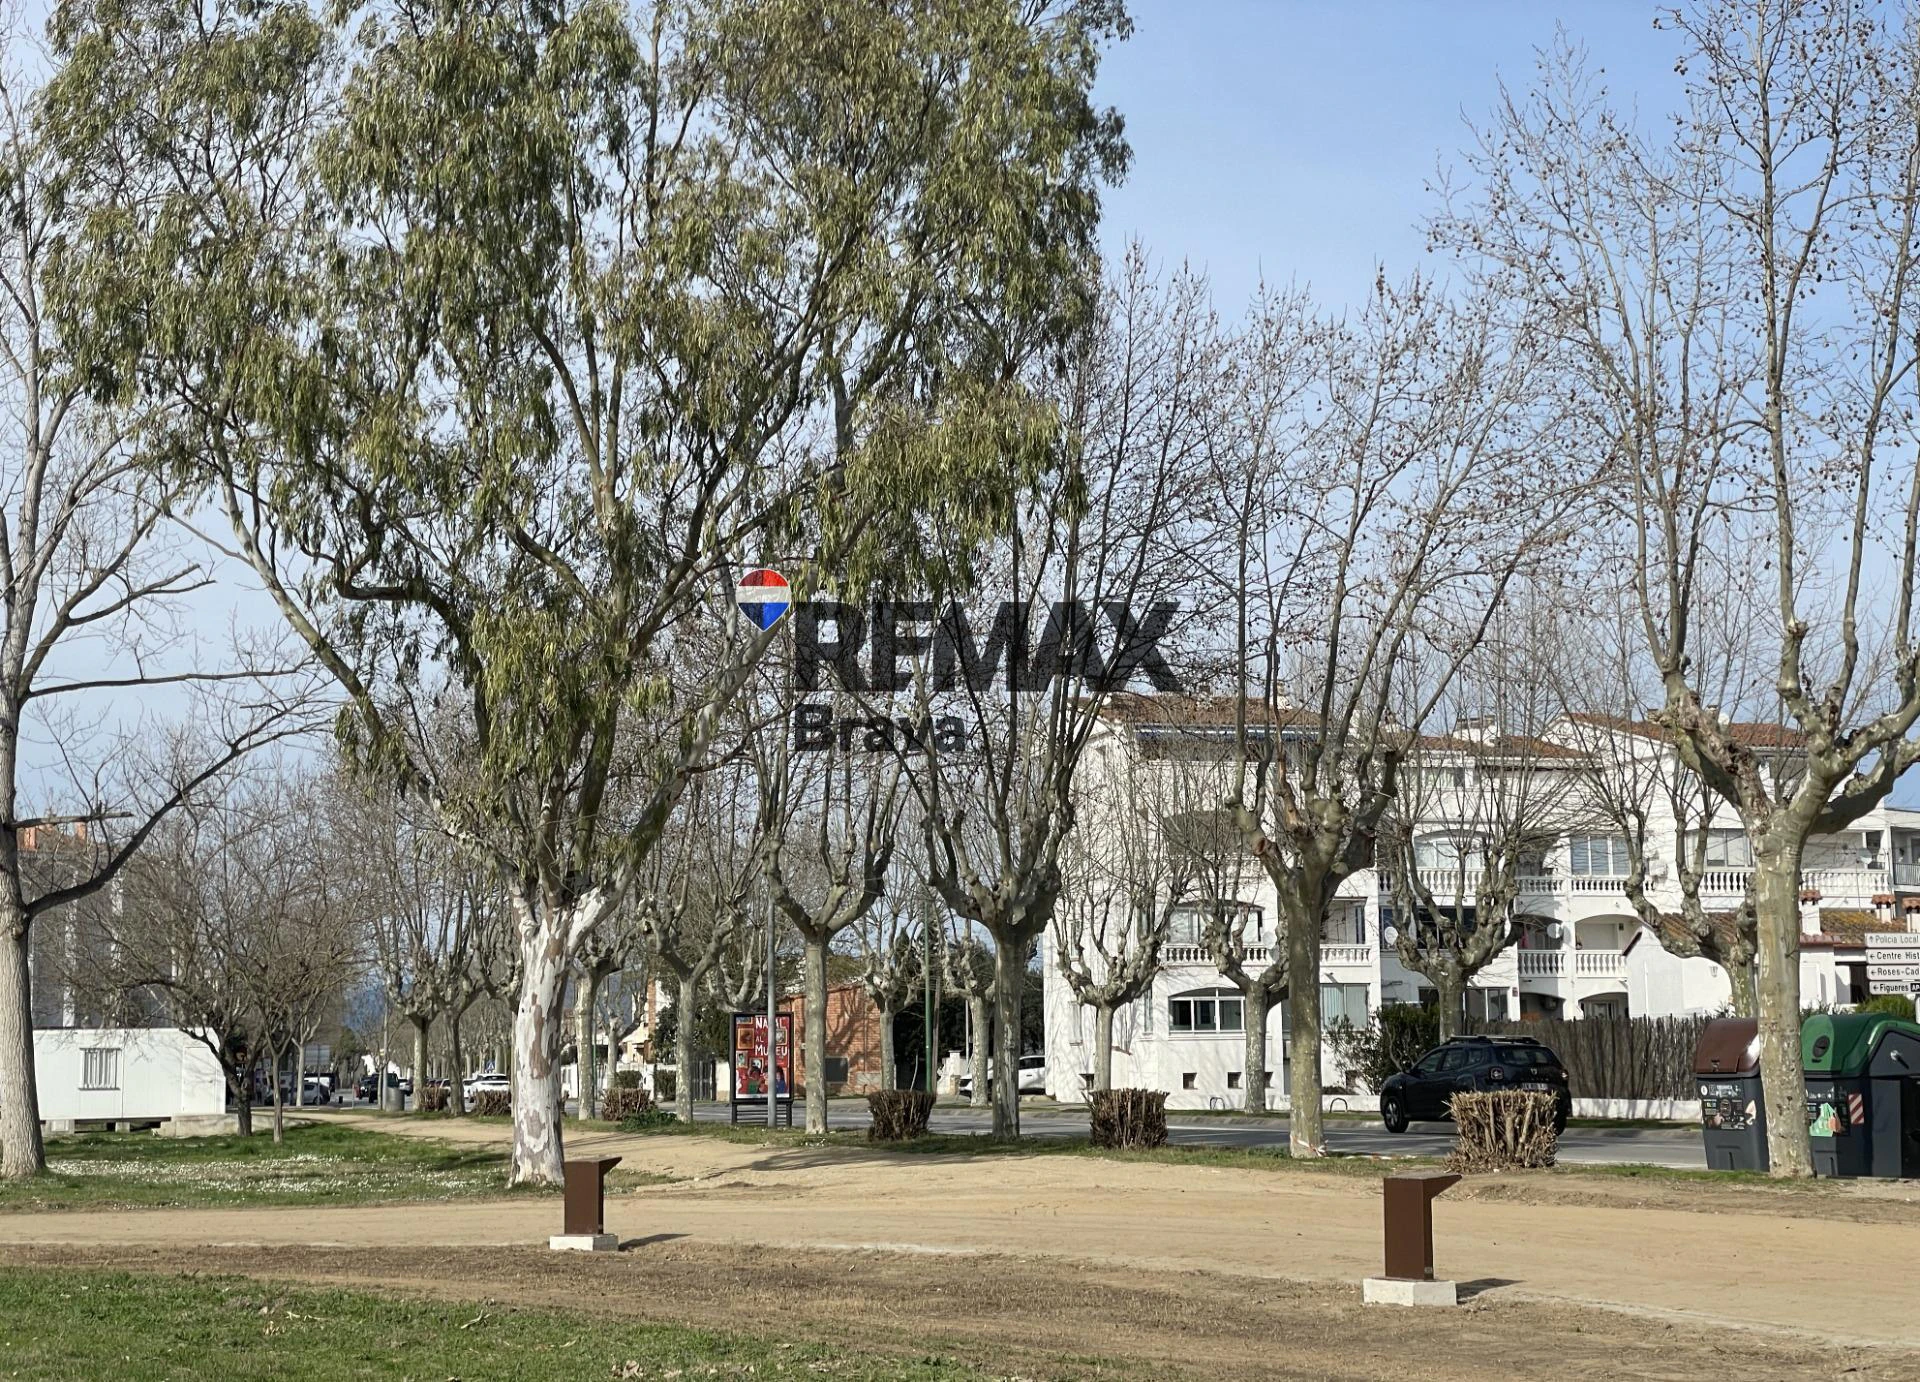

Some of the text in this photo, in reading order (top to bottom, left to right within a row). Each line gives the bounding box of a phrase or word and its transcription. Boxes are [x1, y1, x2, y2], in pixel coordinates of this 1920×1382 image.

[1900, 935, 1919, 944] Local
[1876, 952, 1901, 960] Centre
[1879, 983, 1909, 993] Figueres
[755, 1045, 788, 1056] MUEU
